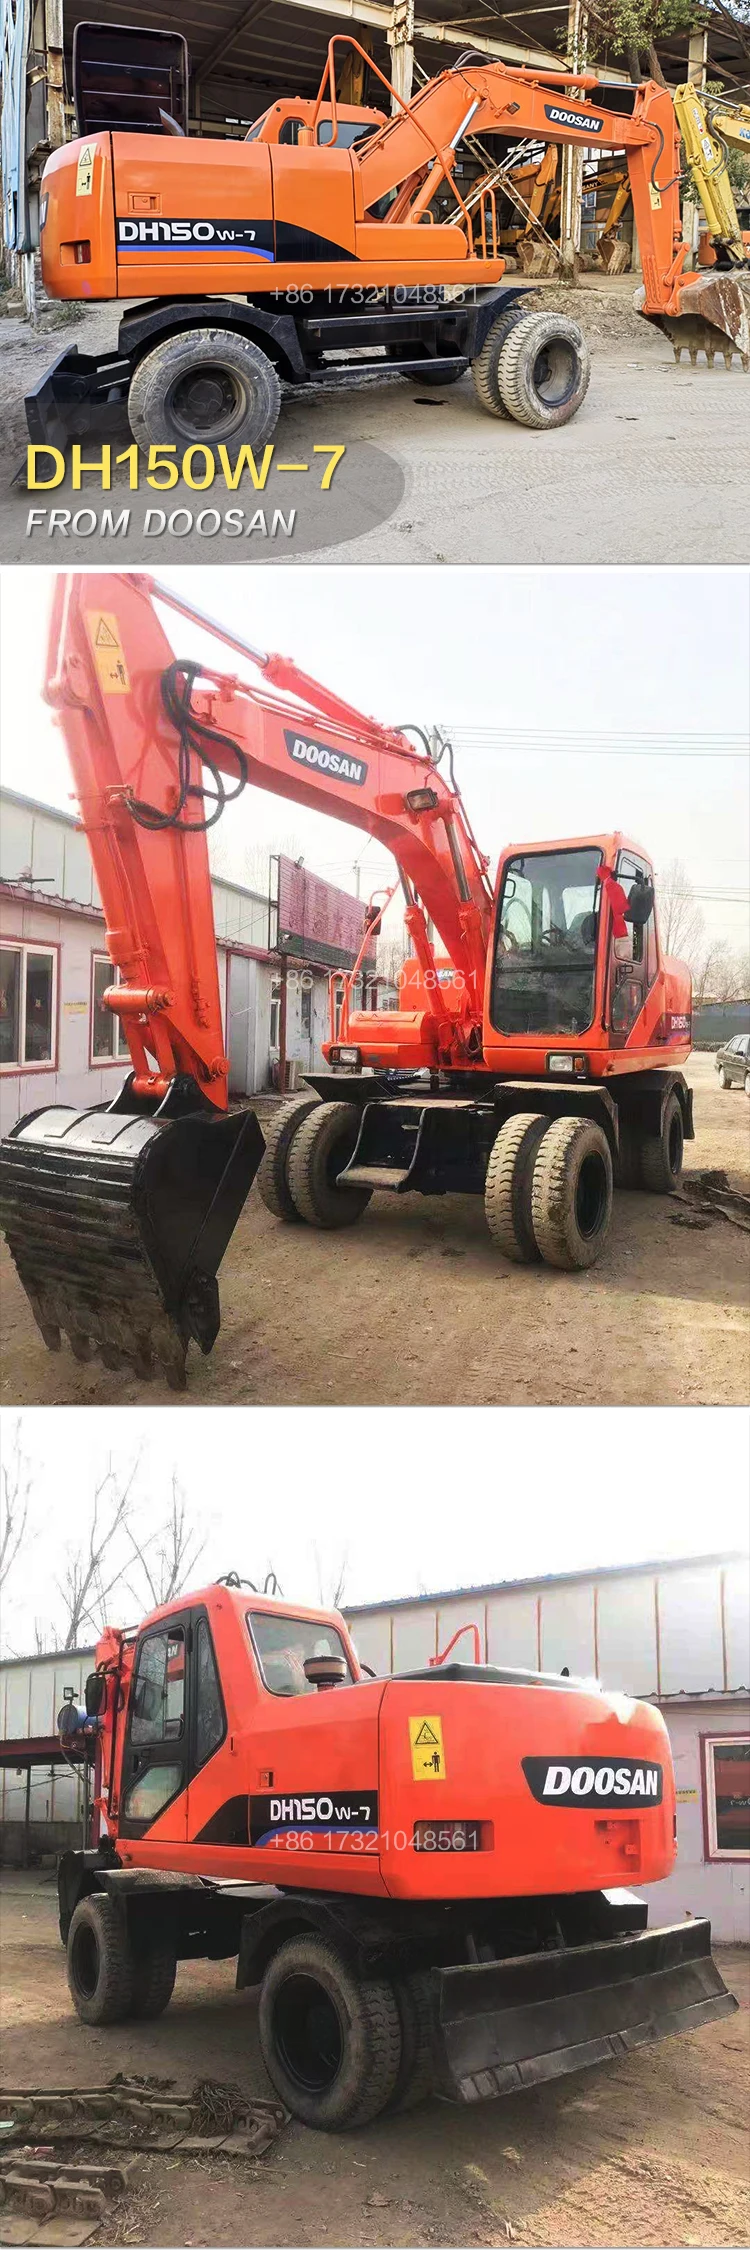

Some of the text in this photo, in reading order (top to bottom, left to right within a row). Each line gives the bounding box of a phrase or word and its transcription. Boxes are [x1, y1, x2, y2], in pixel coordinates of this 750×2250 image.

[549, 109, 600, 130] DOOSAN
[292, 739, 362, 781] DOOSAN
[542, 1766, 658, 1796] DOOSAN
